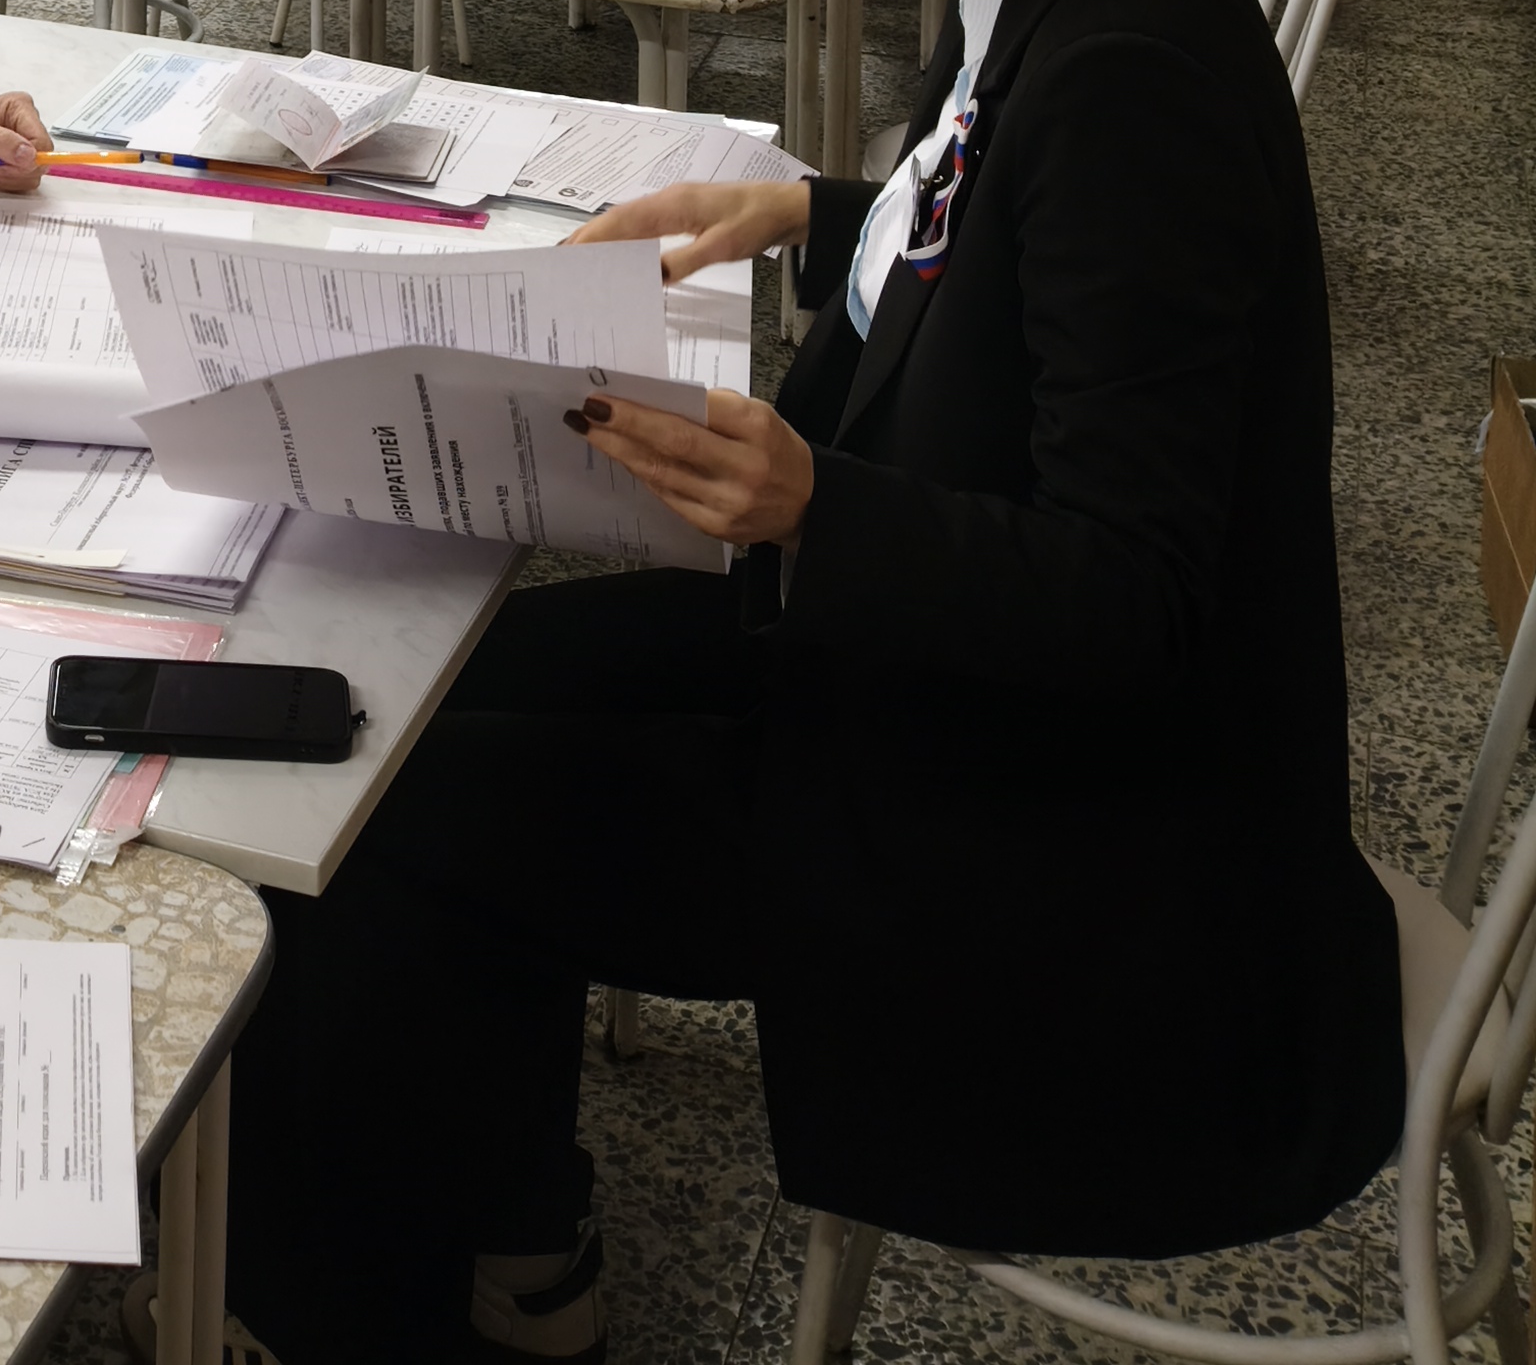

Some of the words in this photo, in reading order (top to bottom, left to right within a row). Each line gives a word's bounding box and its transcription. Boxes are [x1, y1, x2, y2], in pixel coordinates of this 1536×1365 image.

[423, 421, 440, 469] заявления
[377, 425, 414, 522] ИЗБИРАТЕЛЕЙ
[448, 440, 466, 497] нахождения
[497, 485, 507, 496] 839
[433, 471, 450, 514] подавших
[457, 499, 471, 521] месту
